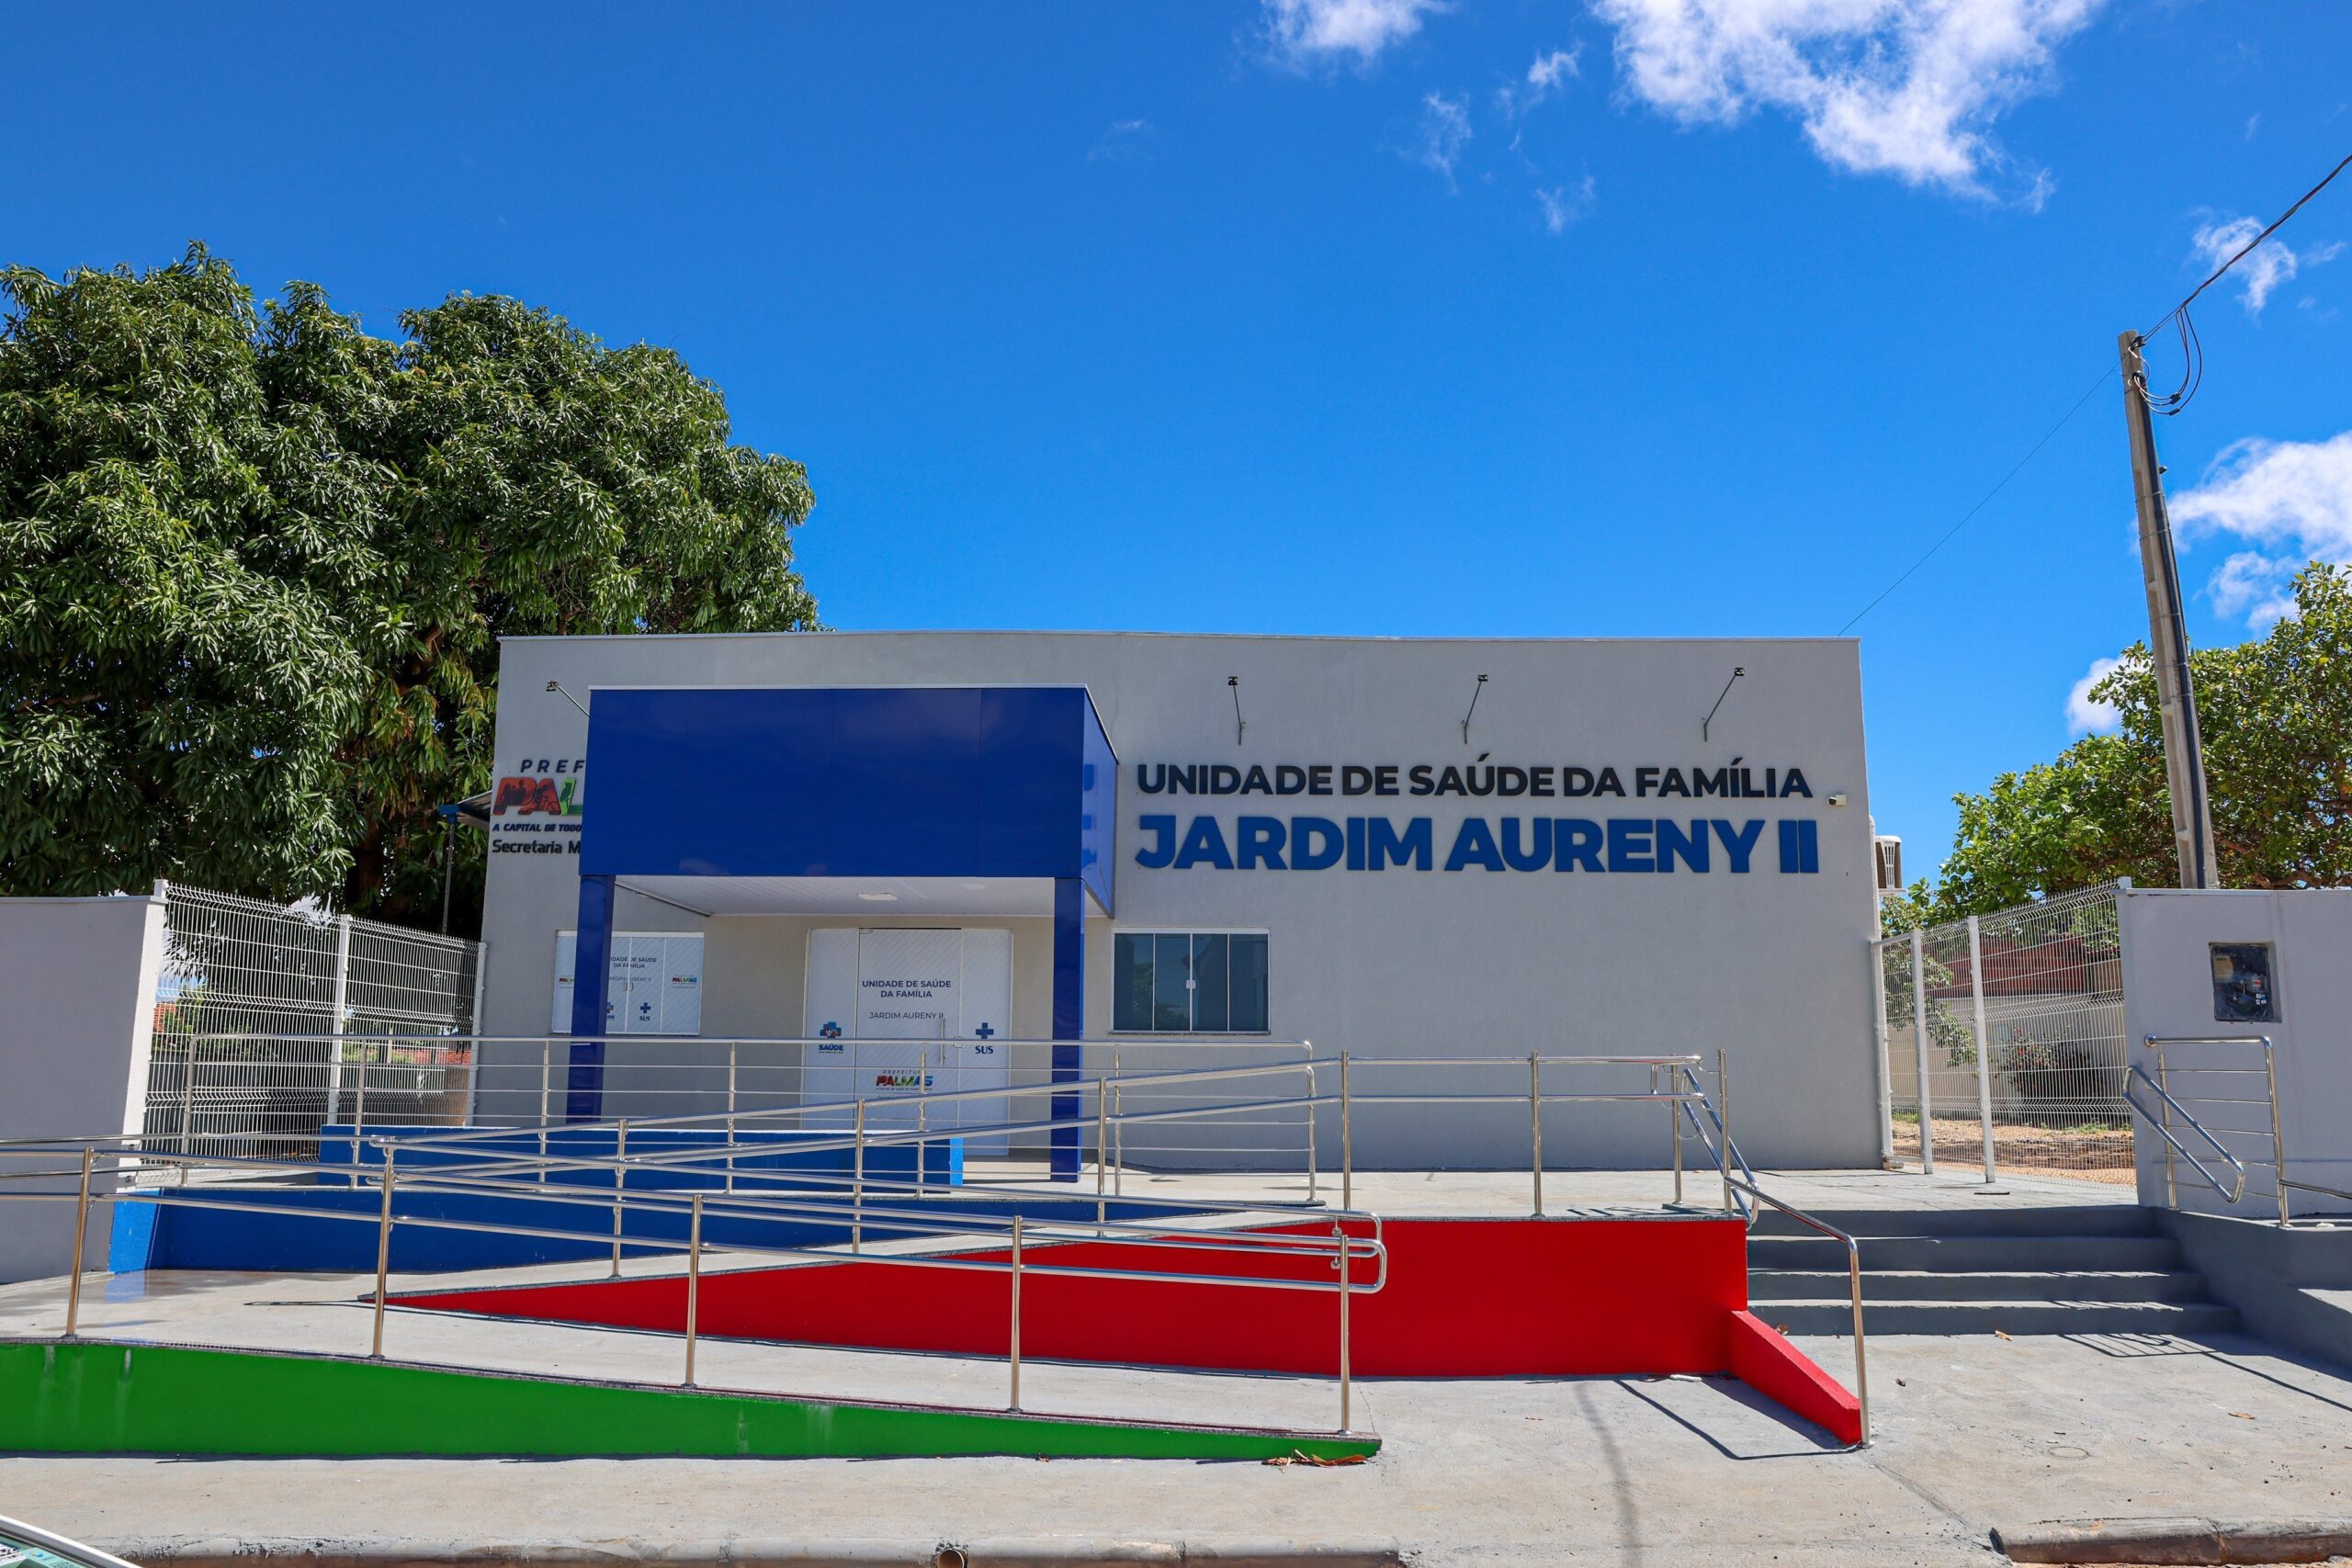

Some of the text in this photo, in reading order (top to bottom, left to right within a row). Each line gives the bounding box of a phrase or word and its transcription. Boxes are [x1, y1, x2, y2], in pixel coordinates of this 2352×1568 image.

[1136, 752, 1815, 799] UNIDADE DE SAÚDE DA FAMÍLIA
[492, 823, 582, 832] A CAPITAL DE TODO
[492, 839, 562, 854] Secretaria
[1136, 813, 1820, 874] JARDIM AURENY II
[921, 978, 952, 987] SAÚDE
[880, 988, 933, 998] DA FAMÍLIA
[869, 1011, 901, 1020] JARDIM
[902, 1011, 937, 1020] AURENY
[818, 1043, 844, 1051] SAÚDE
[975, 1045, 994, 1055] SUS
